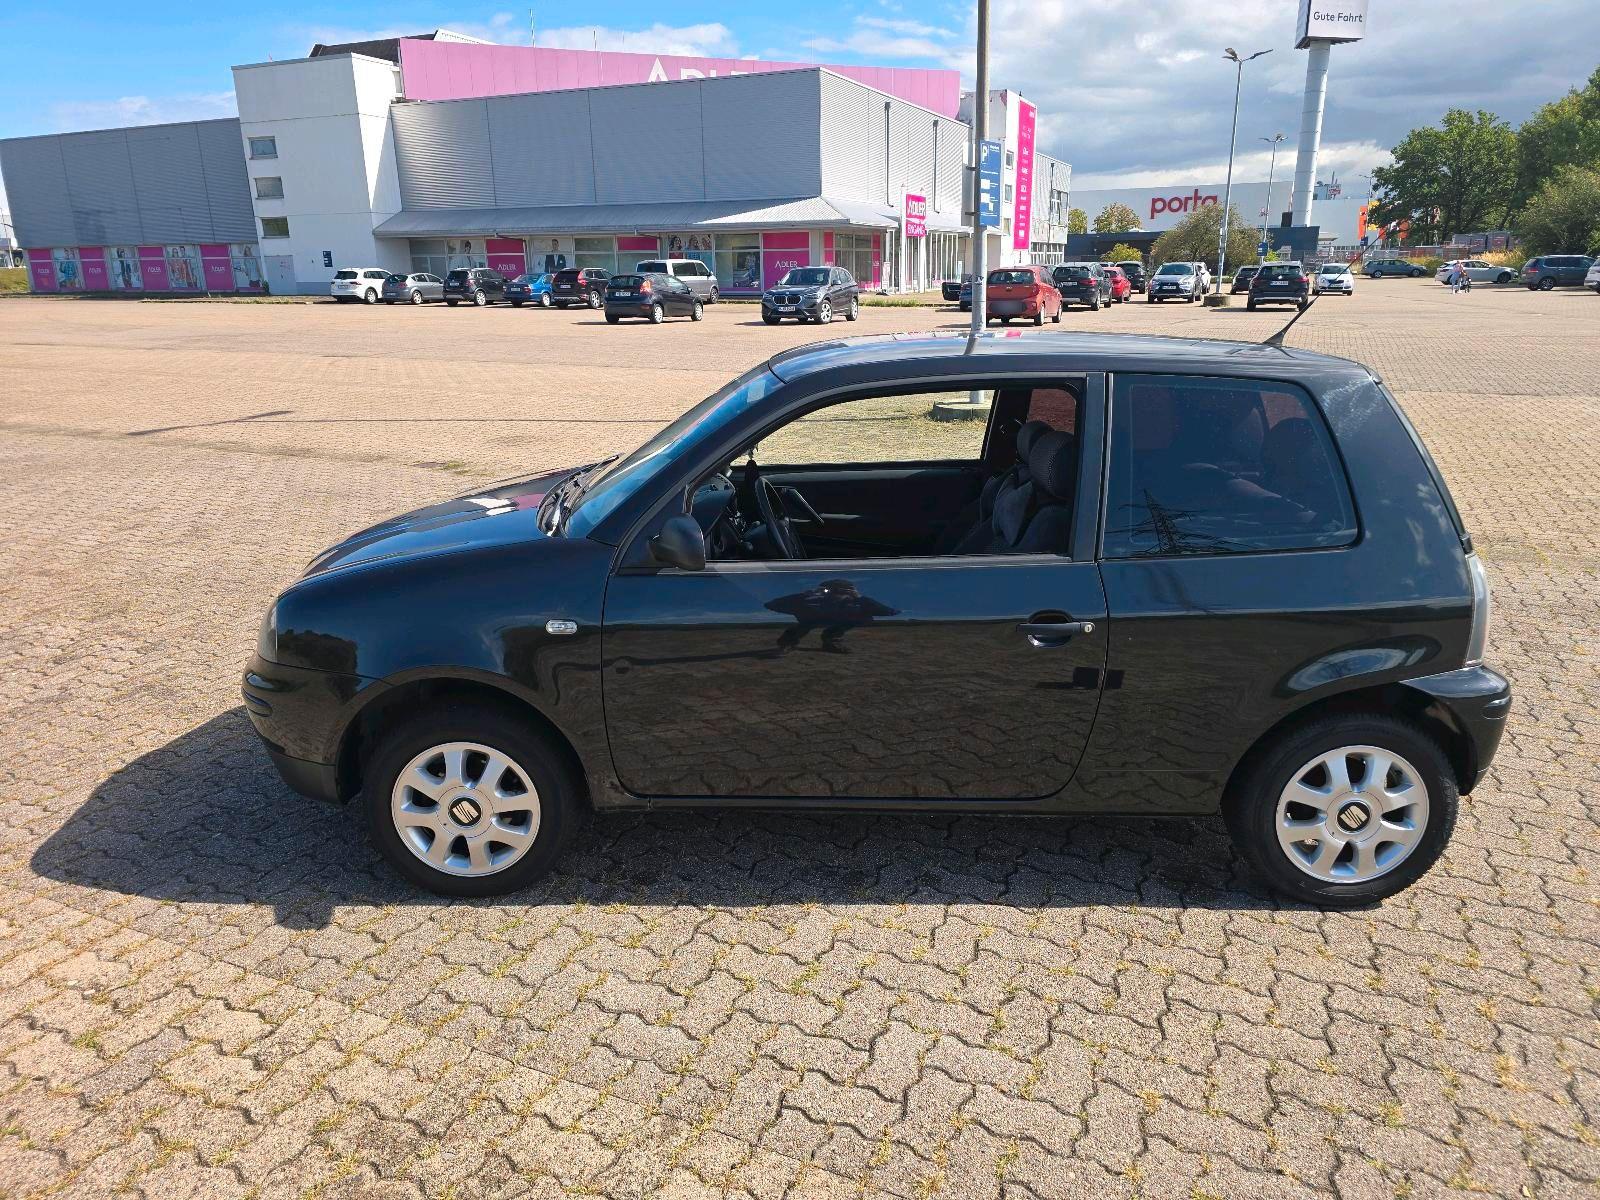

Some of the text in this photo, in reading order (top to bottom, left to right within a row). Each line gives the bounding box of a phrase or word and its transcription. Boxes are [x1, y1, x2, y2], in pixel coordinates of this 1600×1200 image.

[1313, 11, 1363, 23] Gute Fahrt
[907, 199, 926, 217] ADLER
[497, 263, 517, 271] ADLER
[774, 260, 798, 269] ADLER
